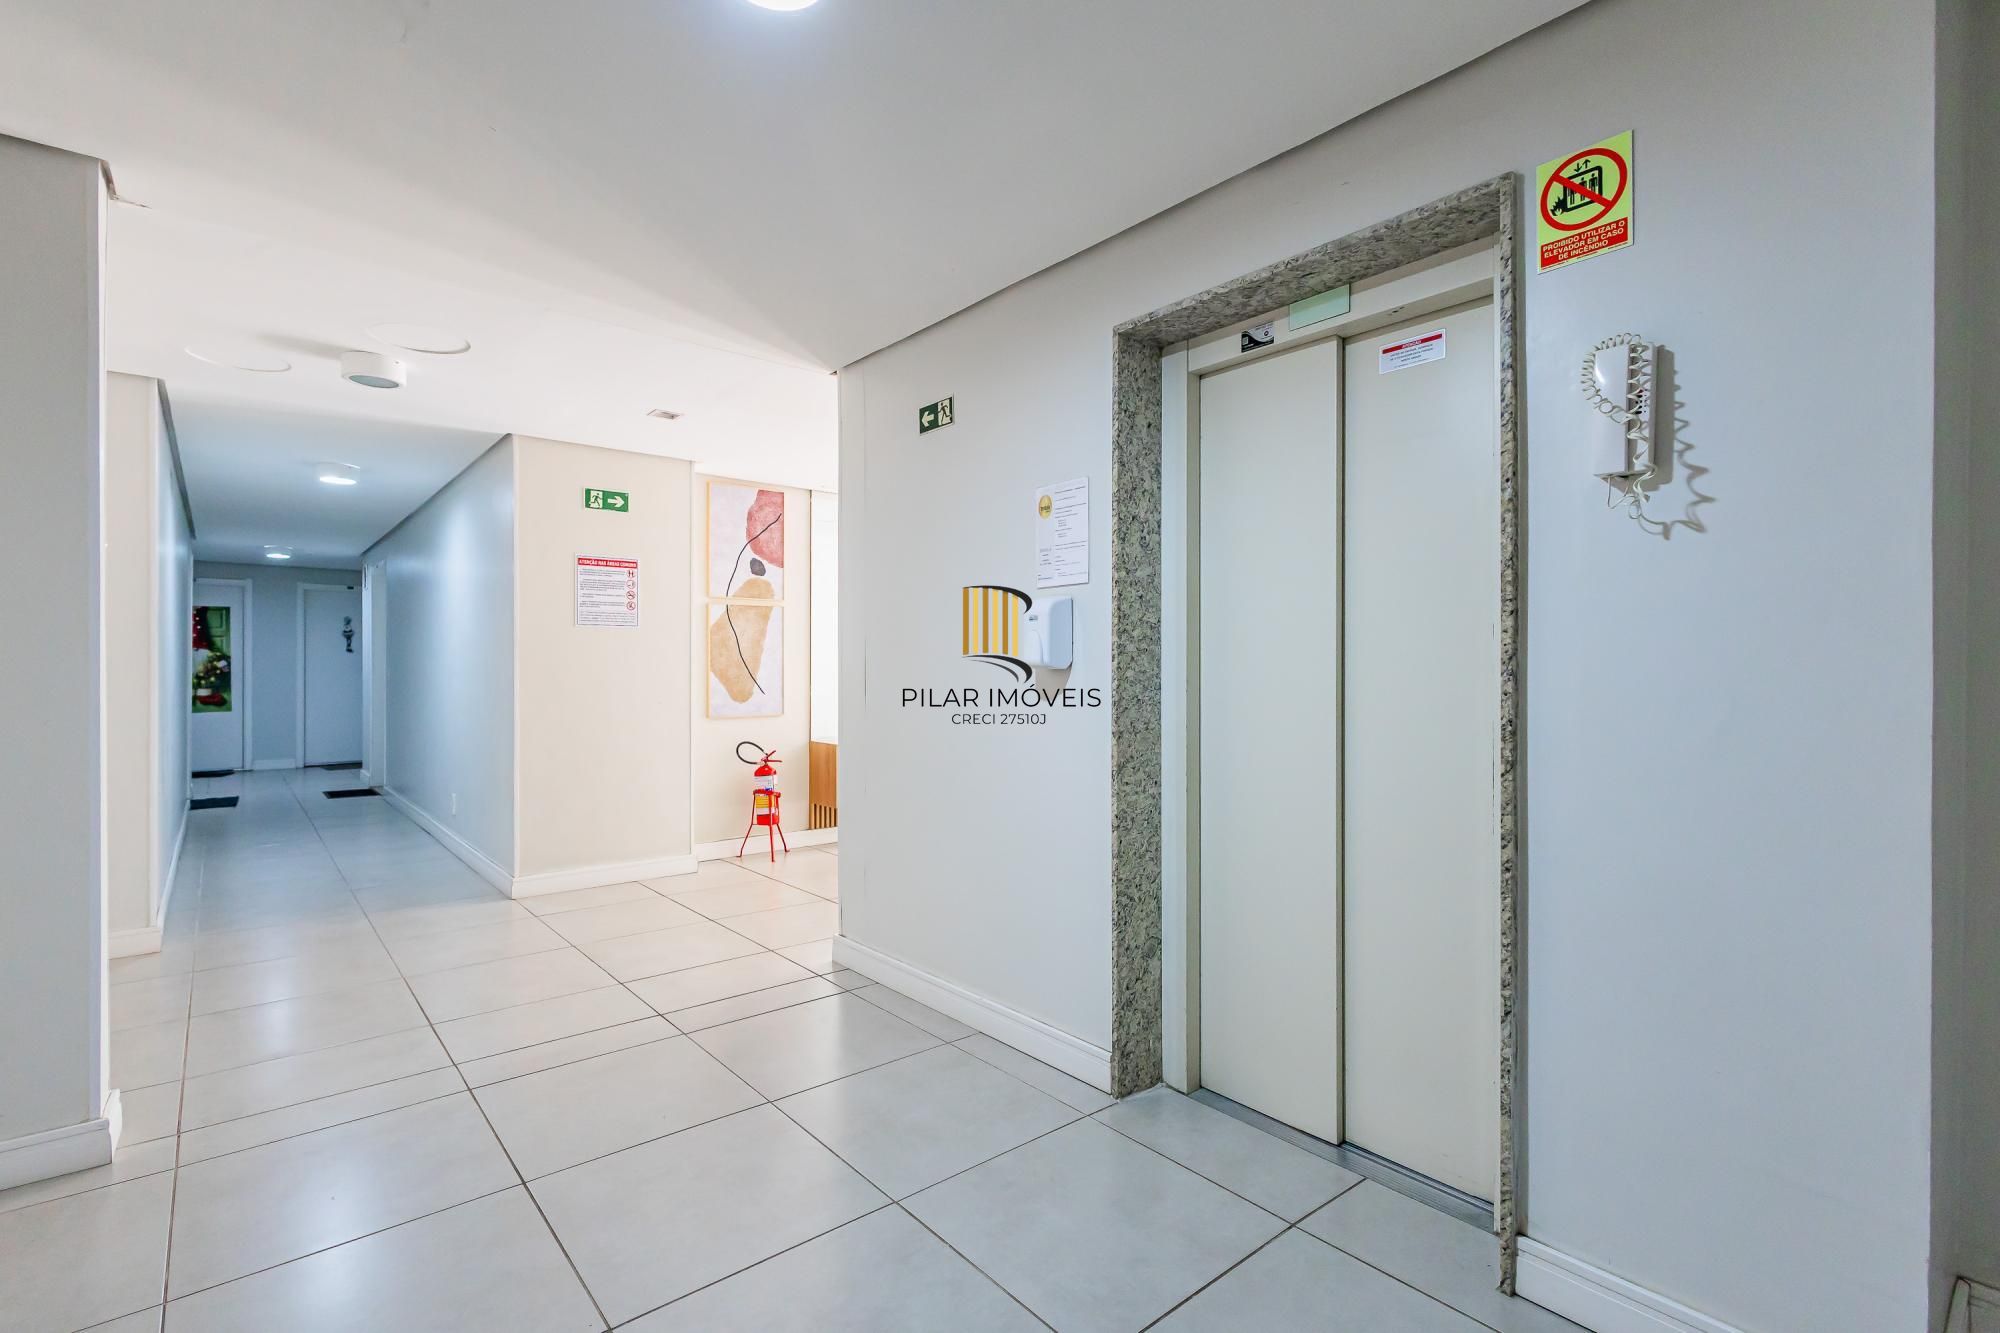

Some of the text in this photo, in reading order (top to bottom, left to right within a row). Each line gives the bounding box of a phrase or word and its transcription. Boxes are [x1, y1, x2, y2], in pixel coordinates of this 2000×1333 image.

[1542, 236, 1580, 252] PROIBIDO
[1581, 223, 1617, 240] UTILIZAR
[1544, 227, 1624, 258] ELEVADOR EM CASO
[1558, 240, 1608, 260] DE INCÊNDIO
